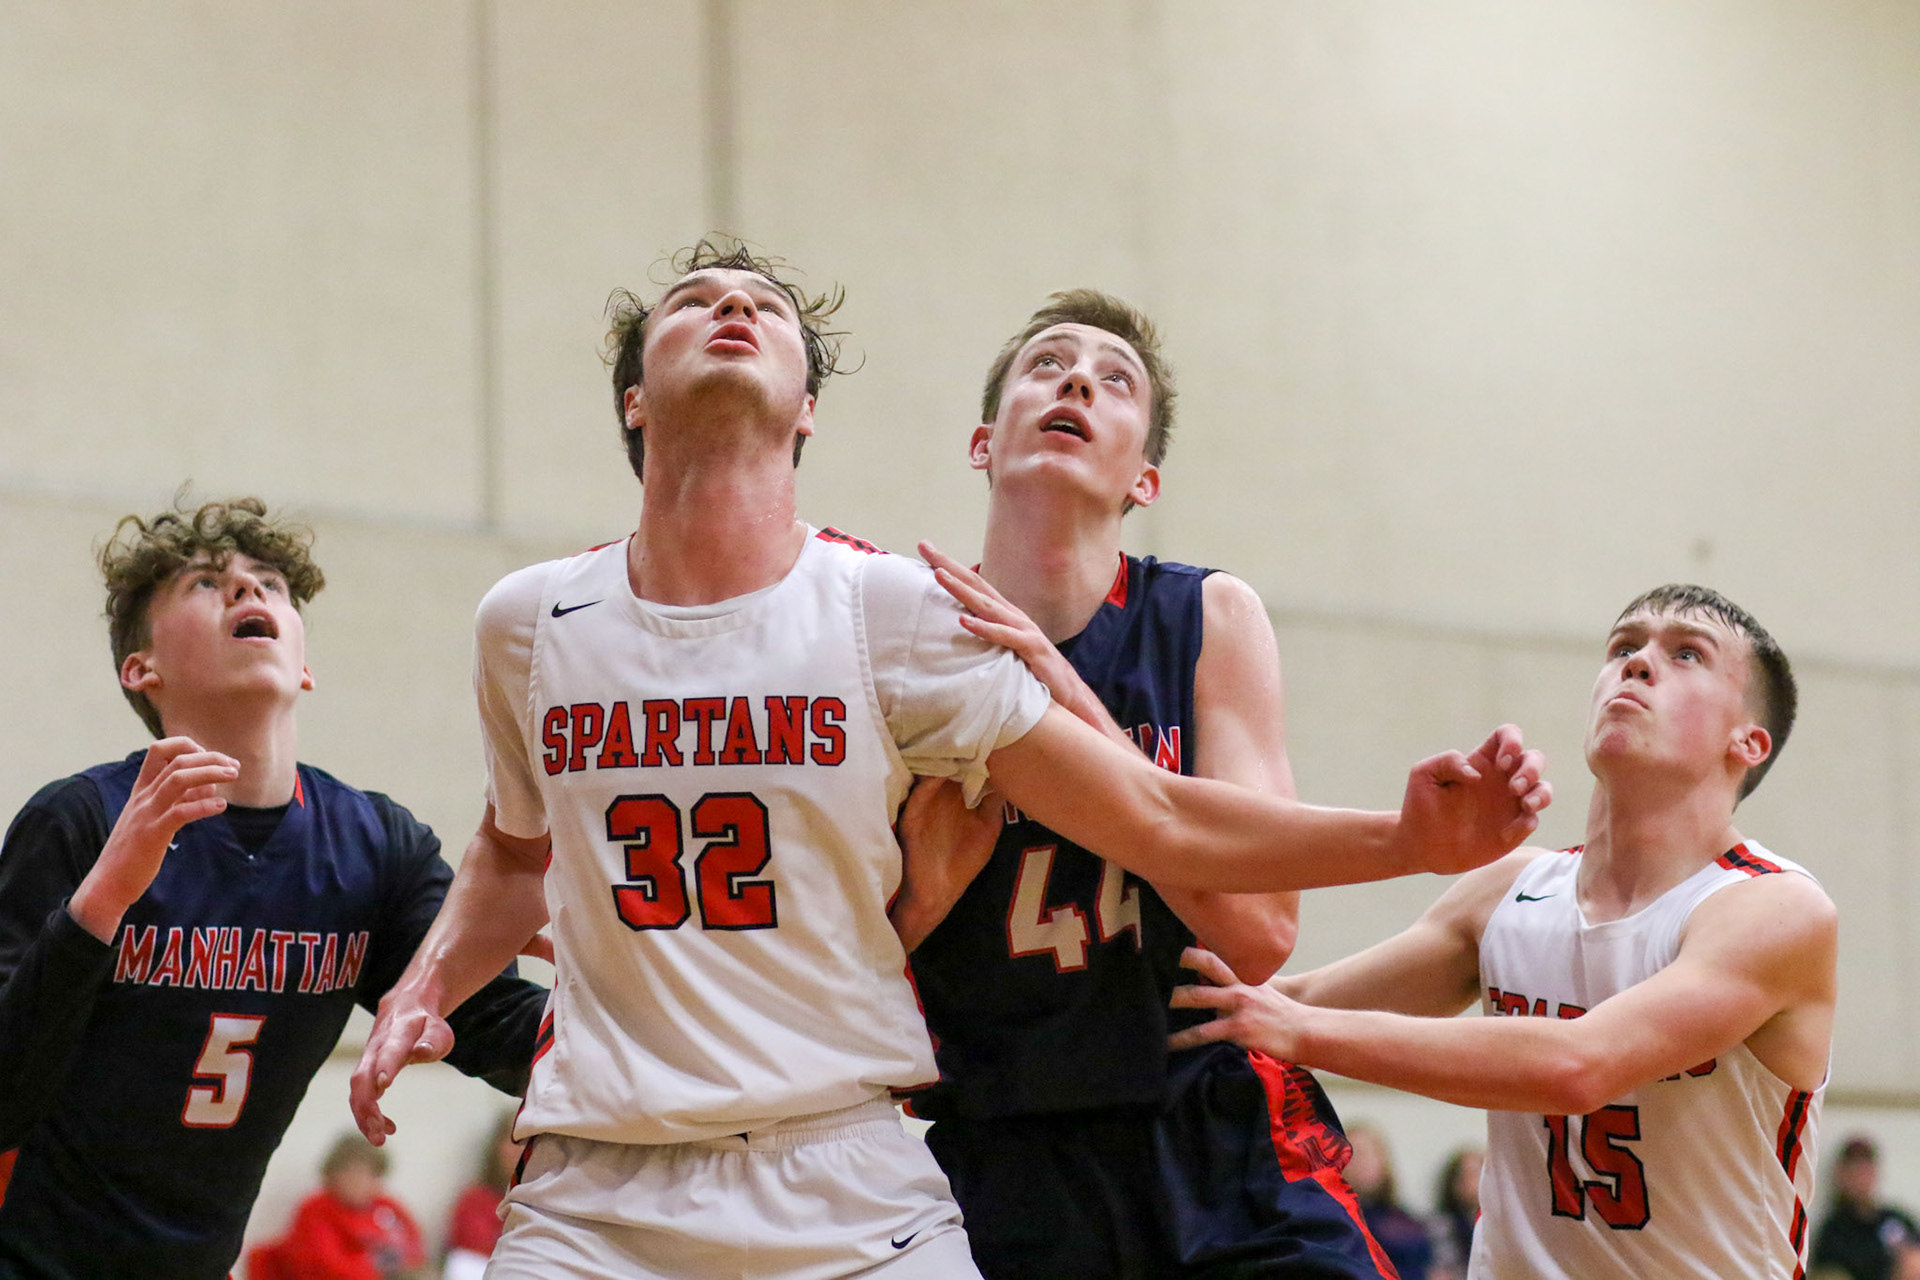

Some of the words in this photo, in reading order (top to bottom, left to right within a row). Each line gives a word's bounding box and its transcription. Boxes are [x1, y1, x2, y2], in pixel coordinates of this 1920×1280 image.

[542, 696, 846, 776] SPARTANS
[605, 791, 778, 931] 32
[1006, 844, 1143, 974] 44
[113, 924, 370, 994] MANHATTAN
[181, 1012, 267, 1128] 5
[1544, 1104, 1651, 1230] 15
